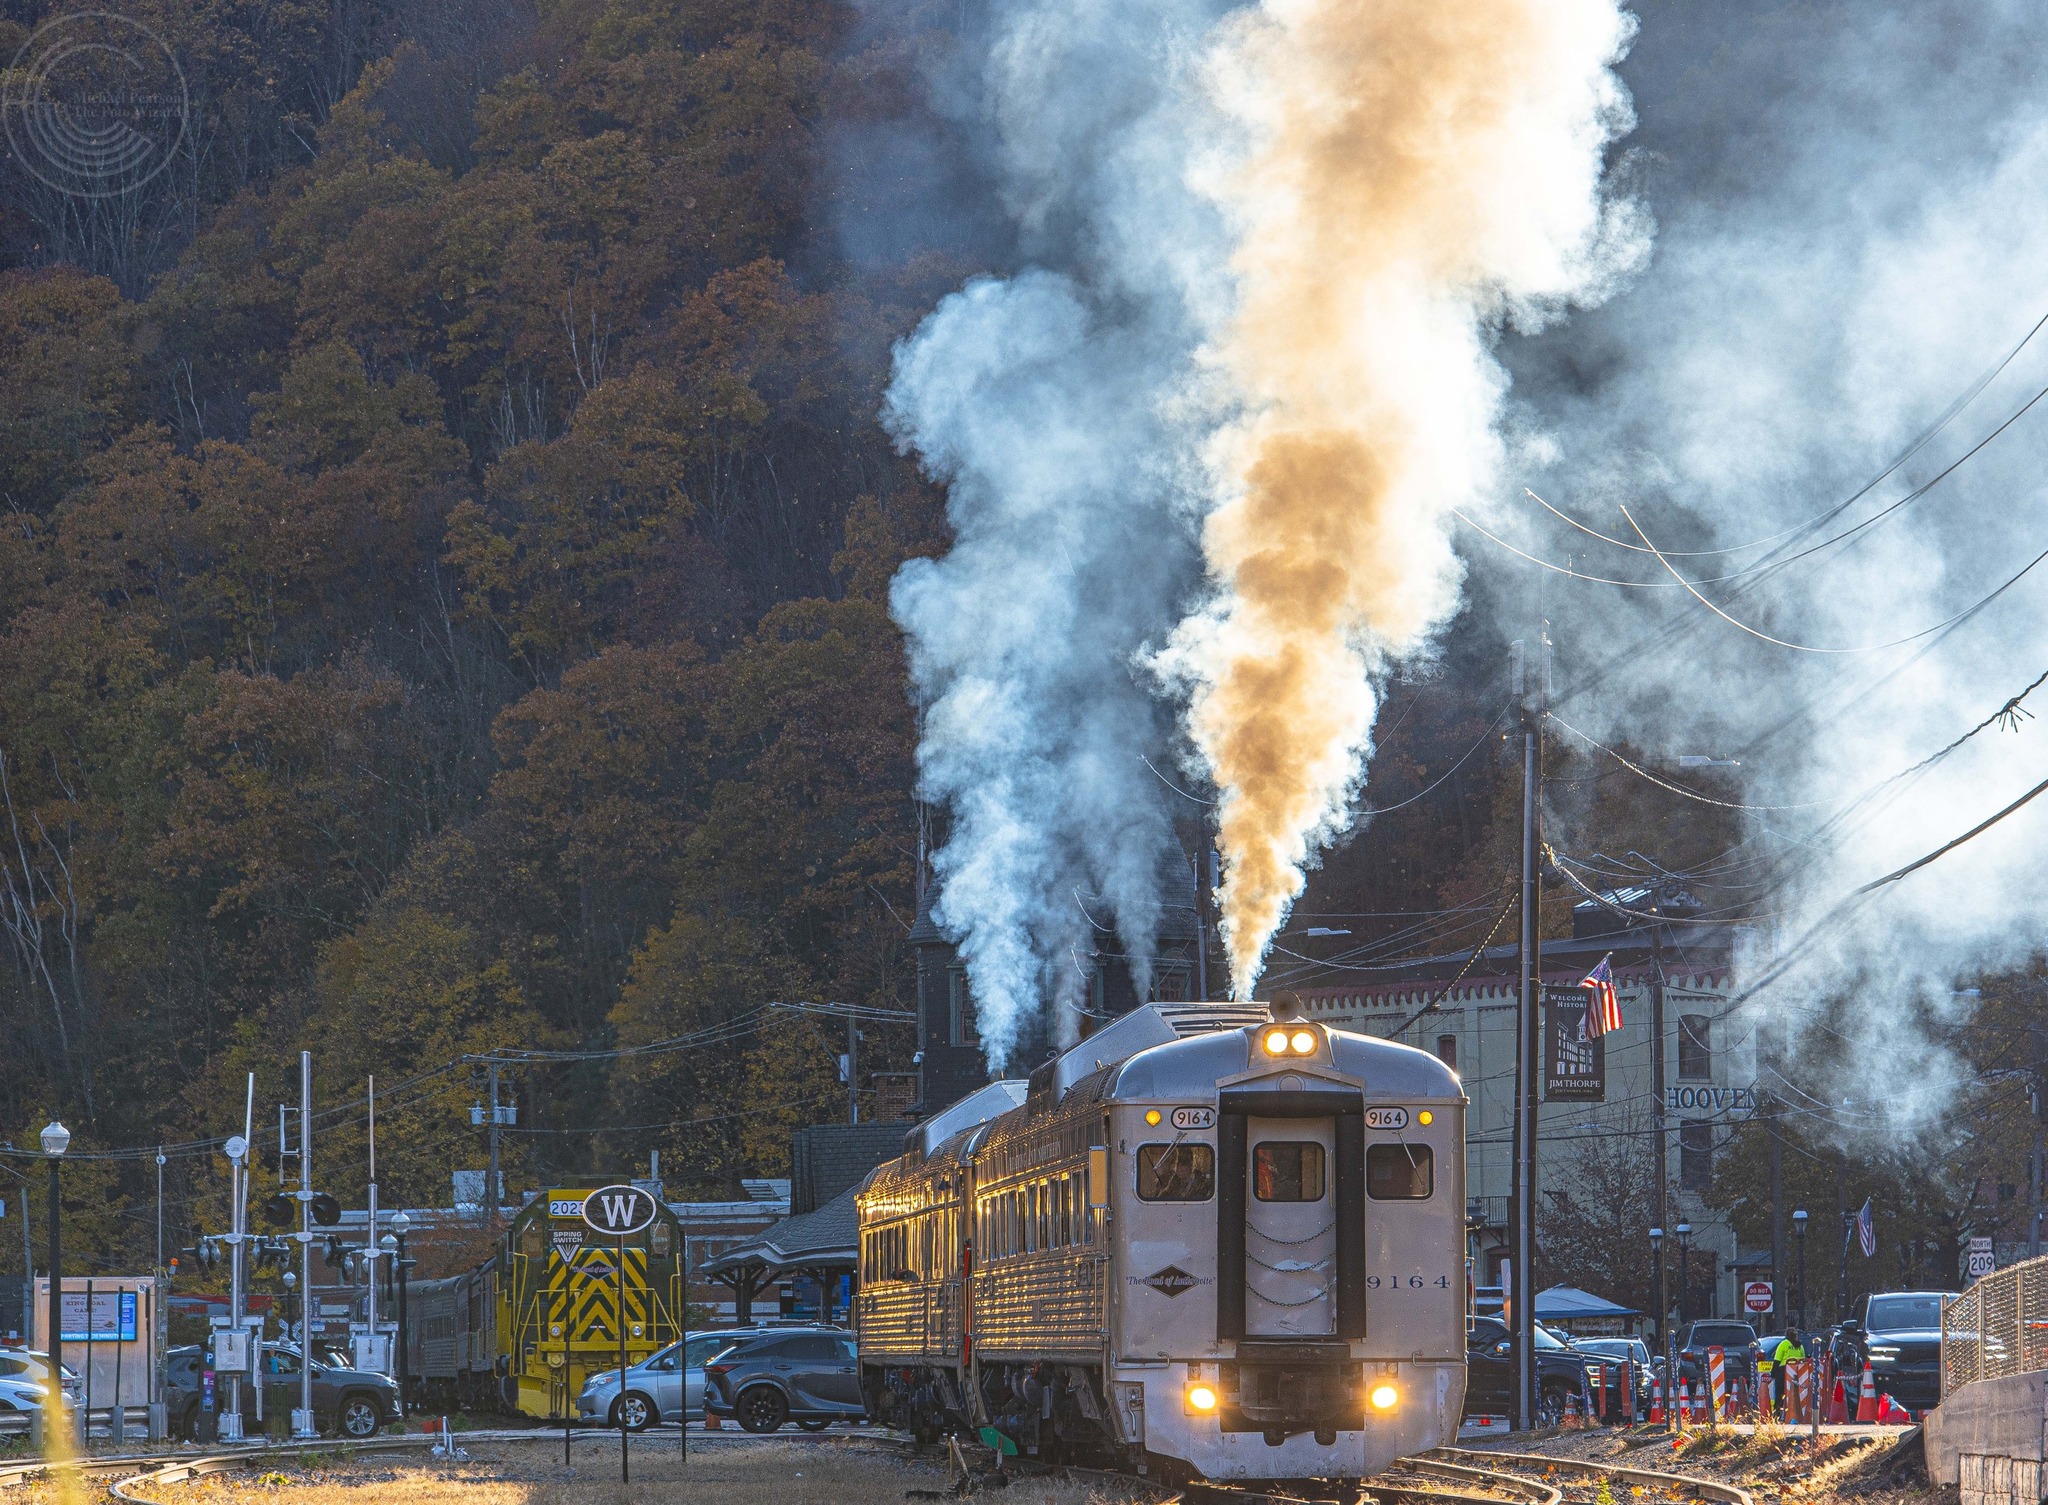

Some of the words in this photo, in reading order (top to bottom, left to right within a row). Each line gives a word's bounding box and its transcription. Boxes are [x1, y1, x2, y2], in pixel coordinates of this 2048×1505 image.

[1549, 1079, 1563, 1089] JIM
[1564, 1080, 1601, 1088] THORPE
[1177, 1111, 1211, 1126] 9164
[1369, 1111, 1402, 1126] 9164
[601, 1194, 637, 1227] W
[1971, 1239, 1991, 1248] NORTH
[1971, 1256, 1993, 1271] 209
[1366, 1275, 1451, 1290] 9164
[206, 1352, 214, 1364] P
